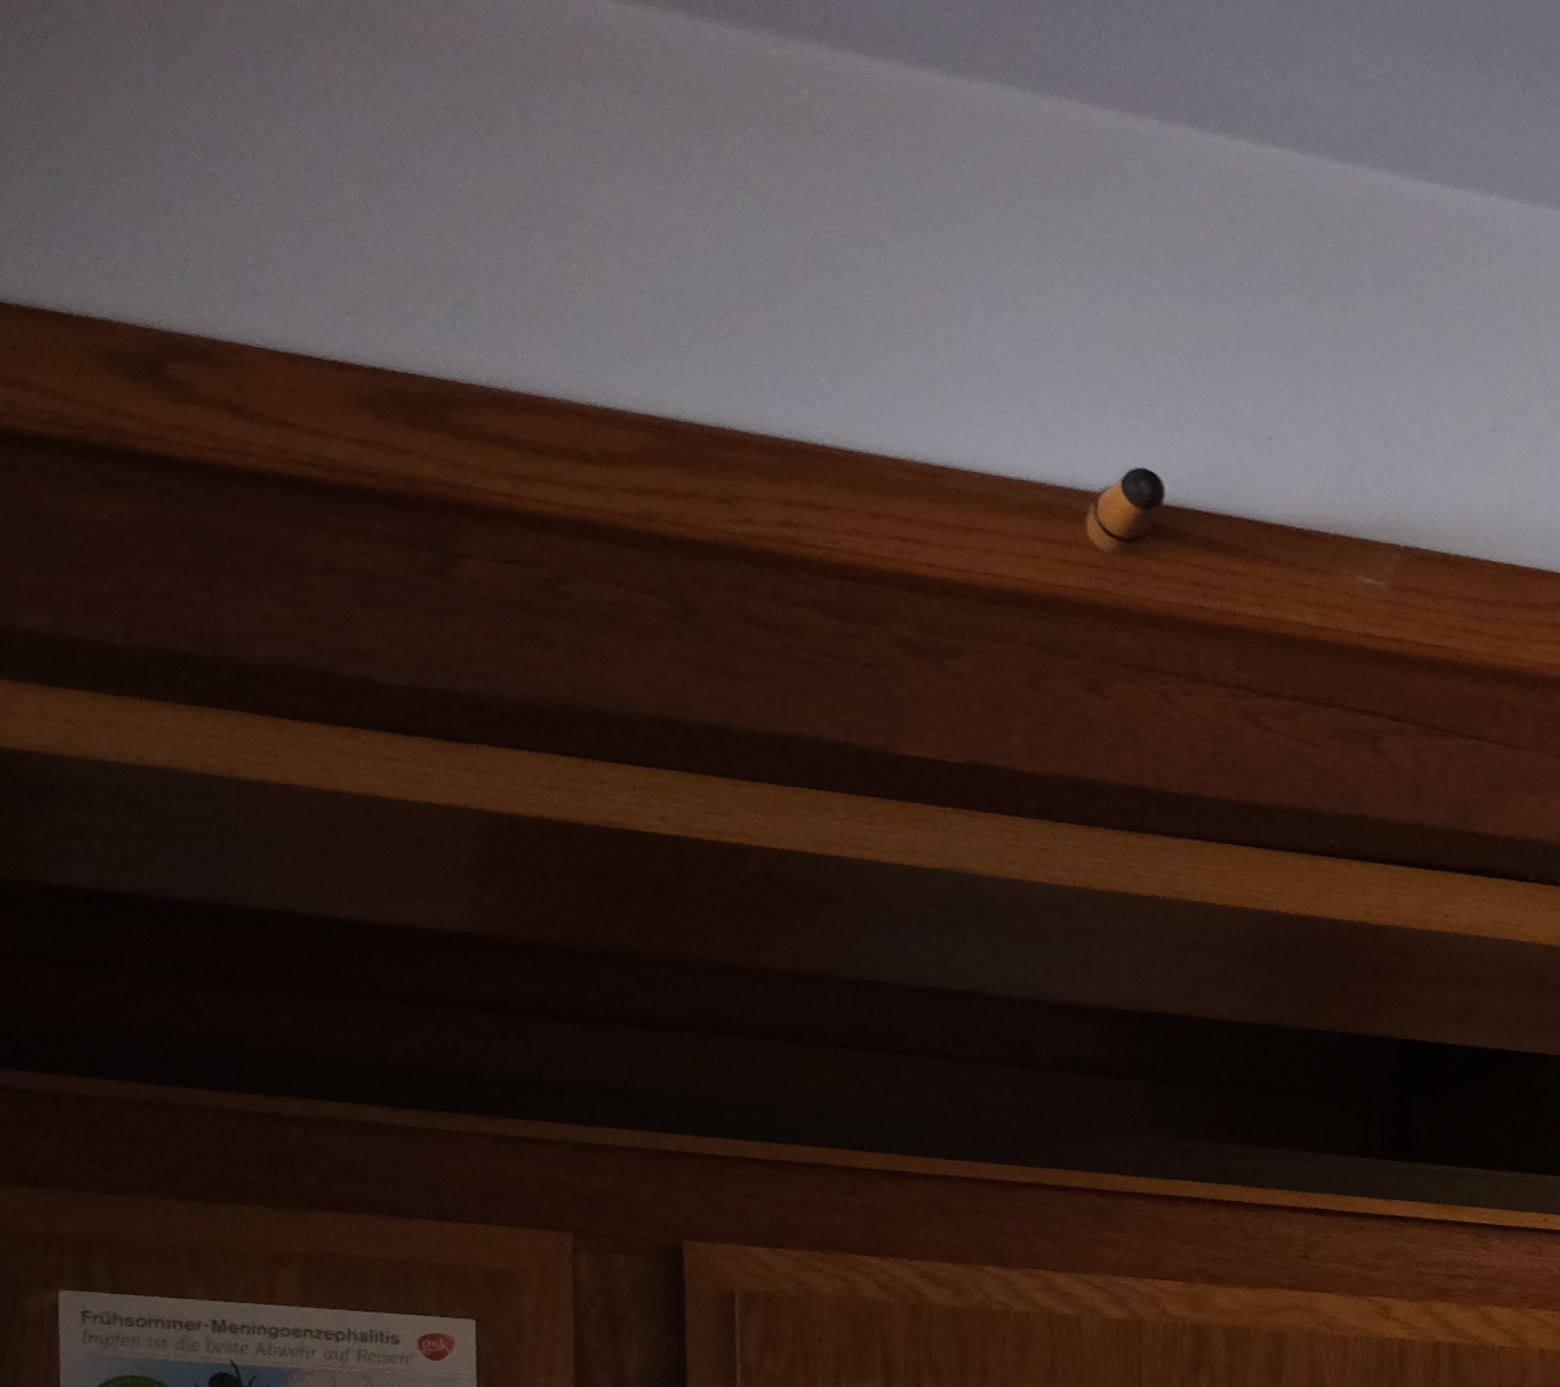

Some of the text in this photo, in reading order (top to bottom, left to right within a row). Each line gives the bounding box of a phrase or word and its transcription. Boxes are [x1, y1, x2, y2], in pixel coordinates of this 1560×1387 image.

[81, 1310, 451, 1356] Frühsommer-Meningoenzephalitis gsk
[174, 1337, 199, 1352] die
[205, 1339, 249, 1355] beste
